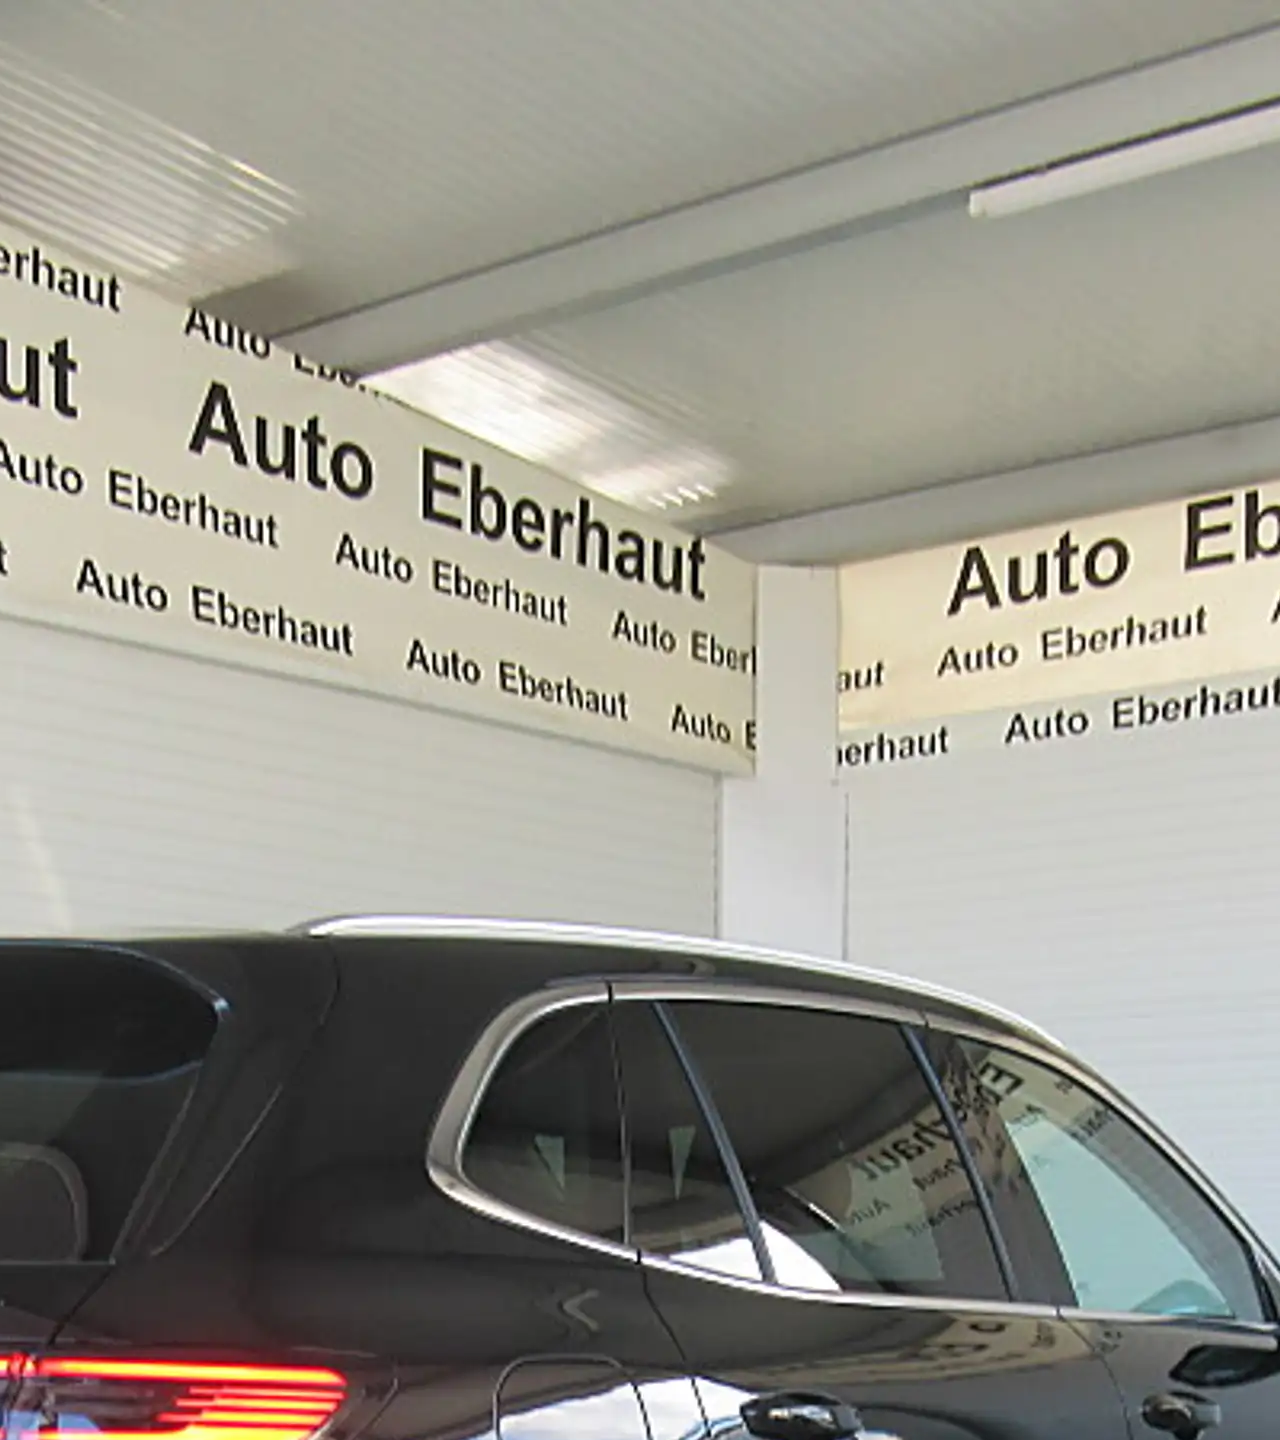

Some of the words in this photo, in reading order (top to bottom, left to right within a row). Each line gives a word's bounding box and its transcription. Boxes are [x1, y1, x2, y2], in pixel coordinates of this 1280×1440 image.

[107, 467, 280, 550] Eberhaut
[187, 378, 375, 502] Auto
[420, 444, 707, 602] Eberhaut
[75, 557, 169, 613] Auto
[190, 583, 354, 658] Eberhaut
[334, 530, 415, 585] Auto
[430, 556, 569, 629] Eberhaut
[946, 529, 1131, 618] Auto
[610, 608, 678, 656] Auto
[936, 640, 1020, 678] Auto
[1040, 604, 1208, 662] Eberhaut
[405, 637, 483, 687] Auto
[497, 658, 630, 723] Eberhaut
[670, 702, 733, 745] Auto
[1003, 707, 1091, 745] Auto
